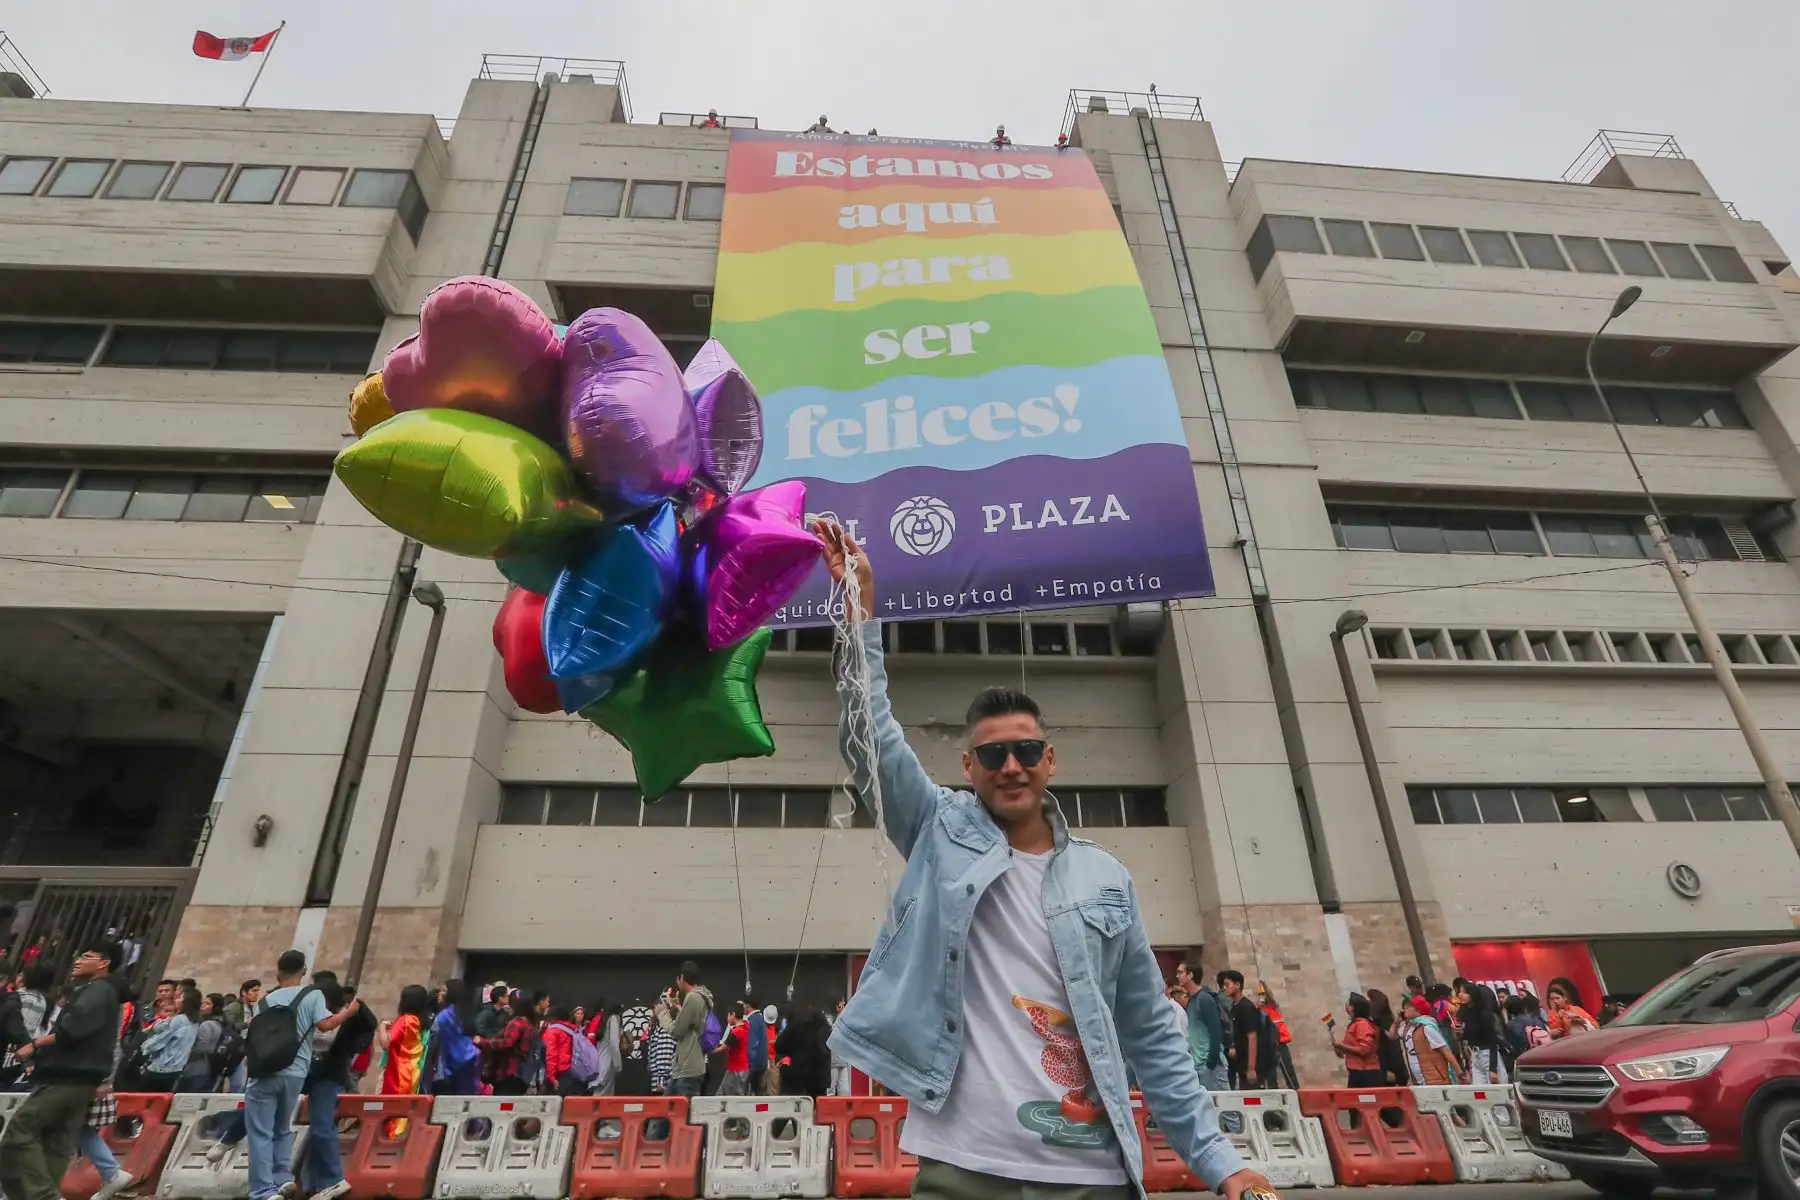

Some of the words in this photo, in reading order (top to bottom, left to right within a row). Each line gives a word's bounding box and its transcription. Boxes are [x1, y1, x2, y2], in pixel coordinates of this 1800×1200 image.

[772, 150, 1054, 181] Estamos
[837, 196, 999, 233] aquí
[832, 250, 1014, 303] para
[863, 319, 991, 366] ser
[784, 383, 1083, 461] felices!
[981, 493, 1131, 534] PLAZA
[774, 599, 846, 623] quida
[884, 583, 1013, 611] +Libertad
[1036, 573, 1162, 598] +Empatía
